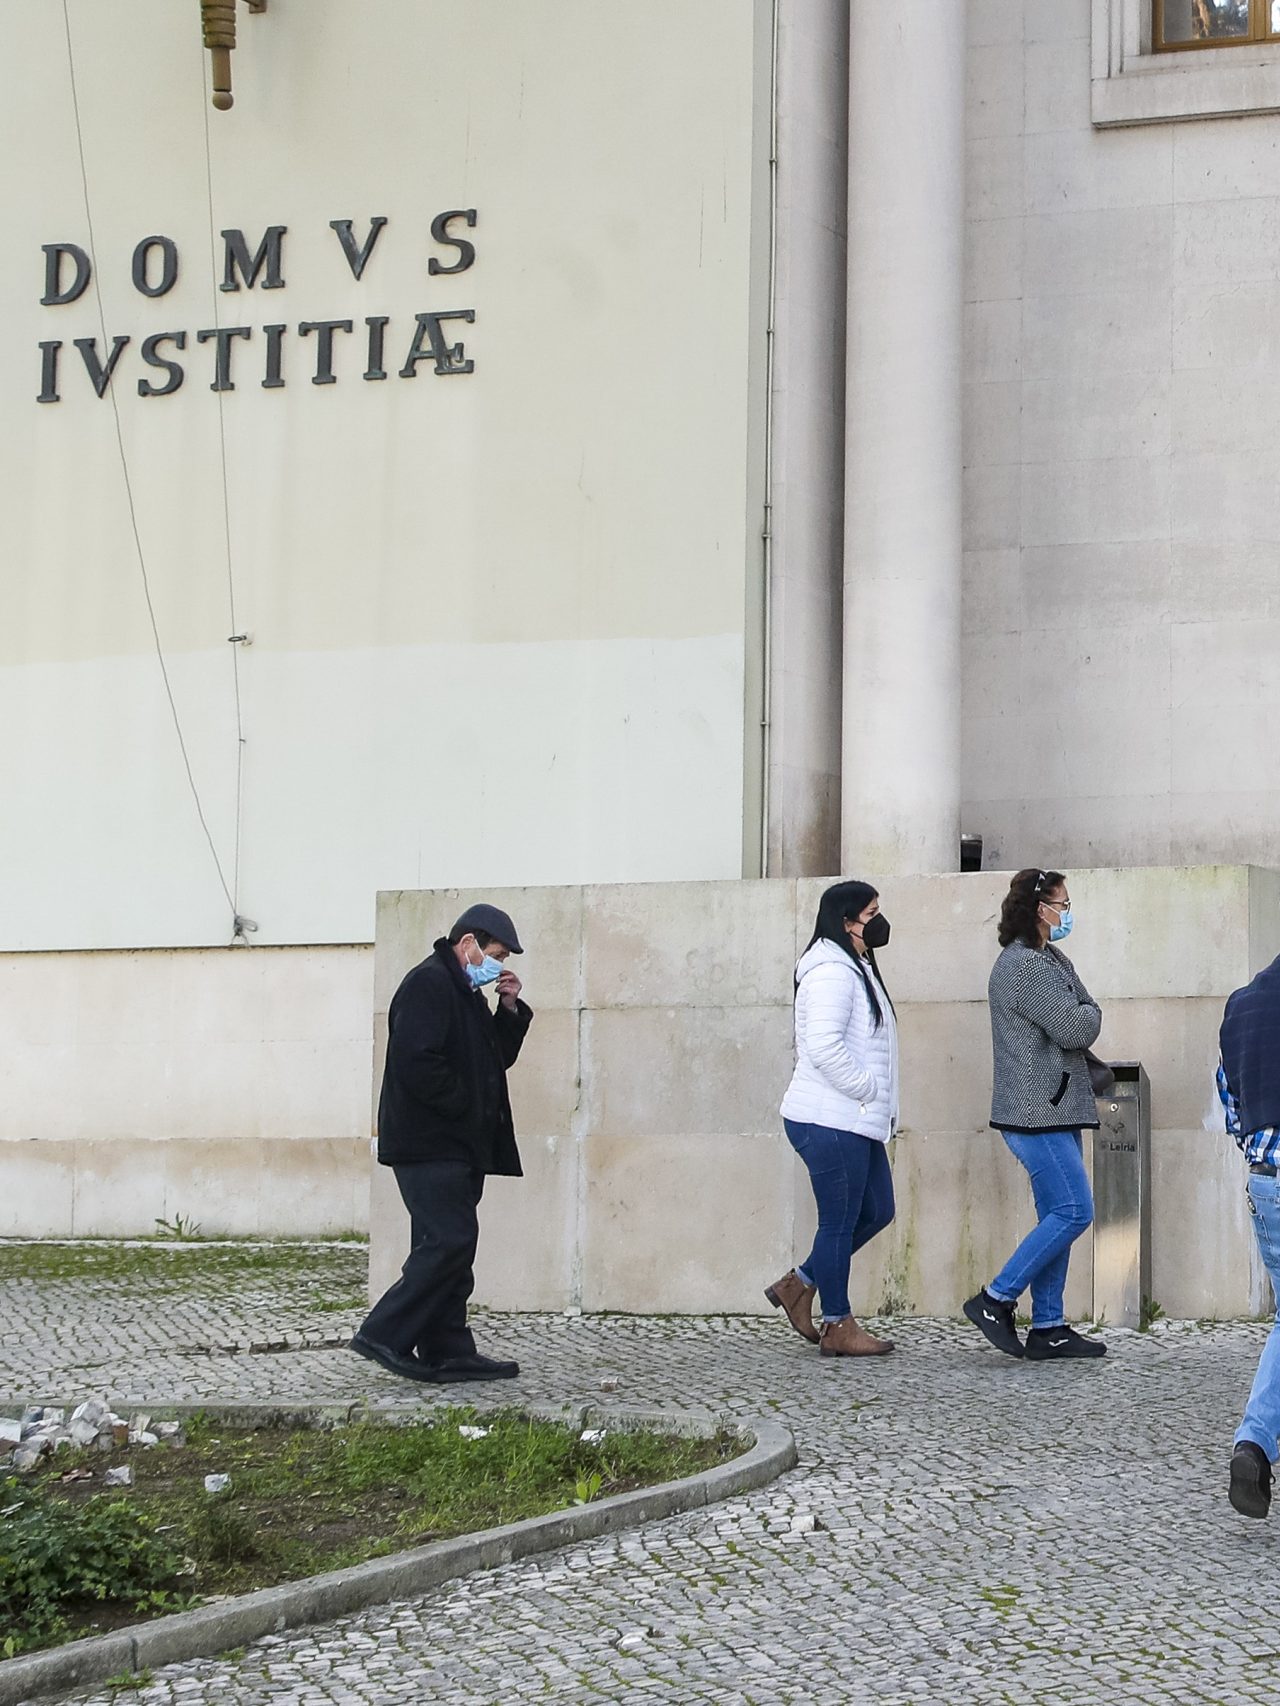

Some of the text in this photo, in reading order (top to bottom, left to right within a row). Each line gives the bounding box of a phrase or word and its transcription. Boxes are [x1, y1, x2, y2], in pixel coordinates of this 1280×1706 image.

[40, 208, 478, 306] DOMVS
[36, 309, 476, 404] IVSTITIÆ
[1110, 1143, 1135, 1152] Leiria
